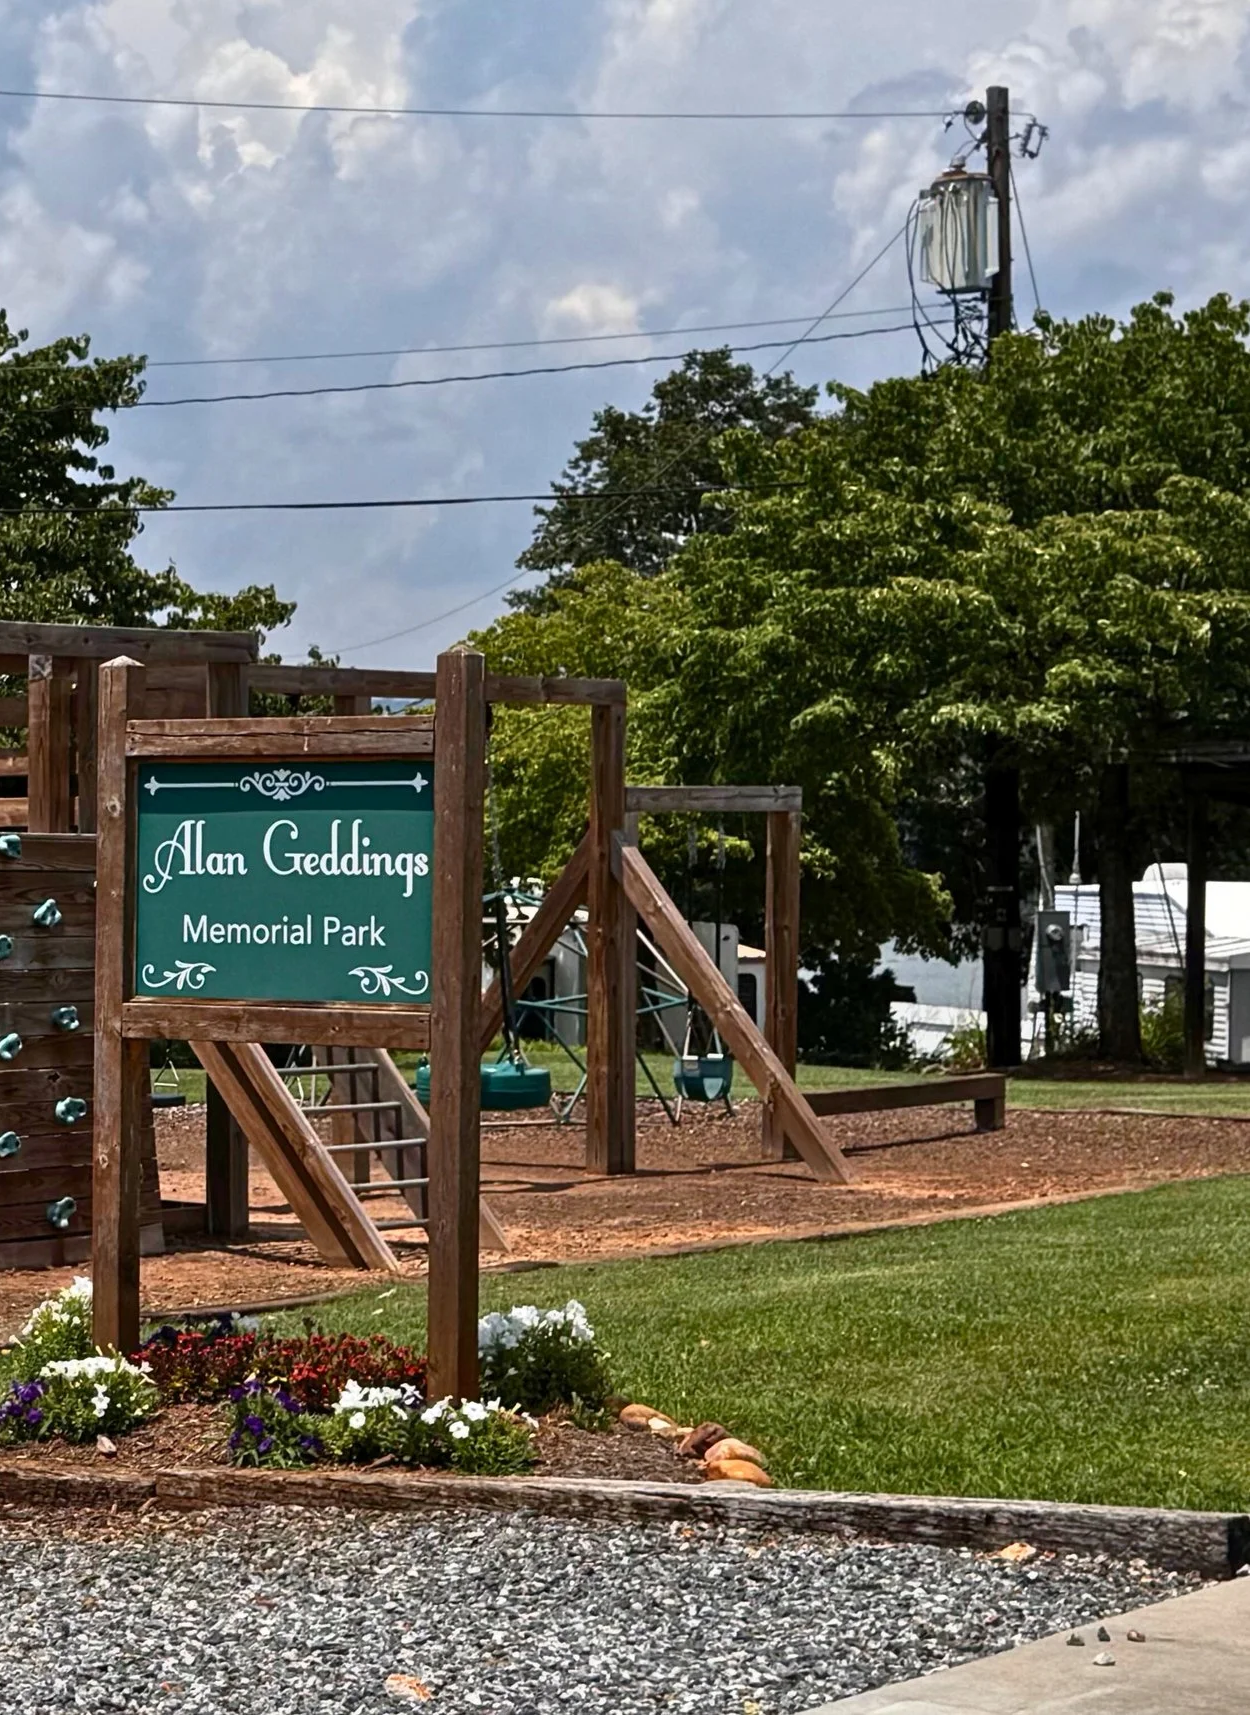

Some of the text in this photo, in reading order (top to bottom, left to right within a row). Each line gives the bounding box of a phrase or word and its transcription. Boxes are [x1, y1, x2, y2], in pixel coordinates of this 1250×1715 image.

[143, 819, 429, 897] Alan Geddings
[183, 914, 386, 946] Memorial Park
